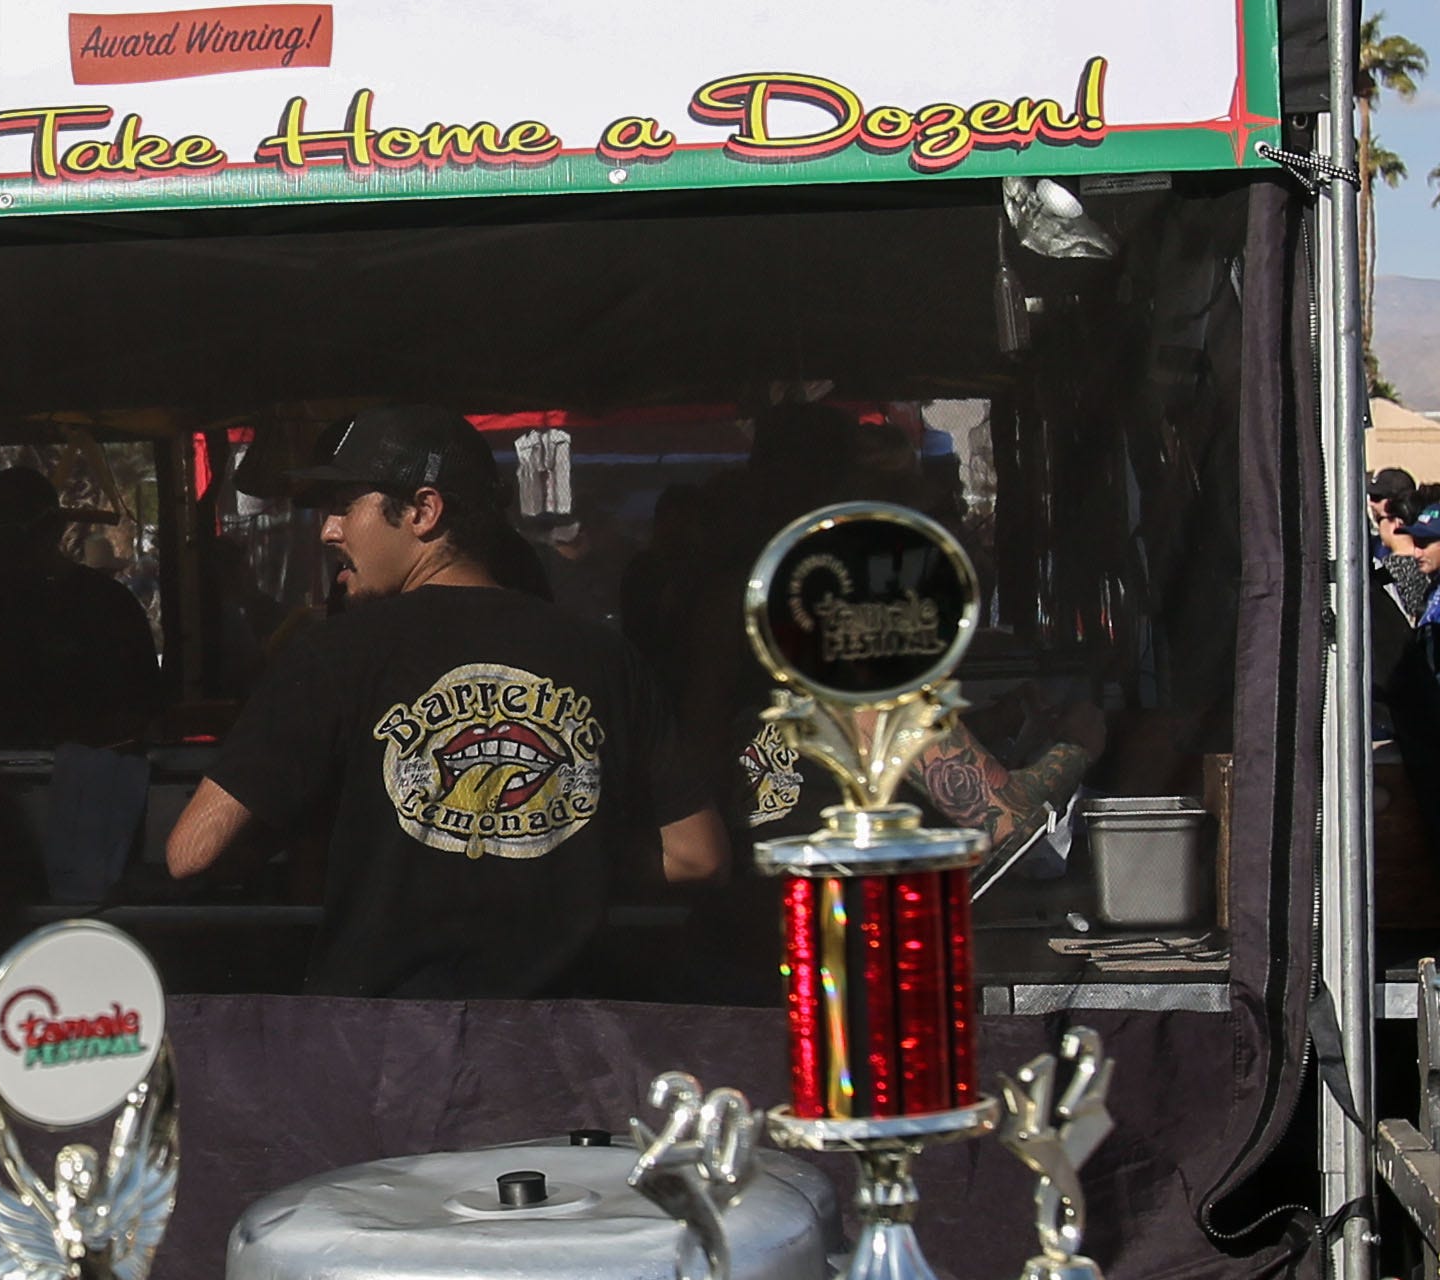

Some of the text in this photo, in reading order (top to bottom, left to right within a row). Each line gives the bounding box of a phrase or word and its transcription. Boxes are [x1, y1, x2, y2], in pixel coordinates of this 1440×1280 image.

[78, 15, 322, 66] Award Winning!
[254, 87, 561, 174] Home
[596, 115, 676, 164] a
[687, 56, 1109, 172] Dozen!
[375, 678, 604, 758] Barrett's
[401, 788, 596, 833] Lemonade
[17, 1001, 140, 1048] tamale
[23, 1034, 148, 1070] FESTIVAL
